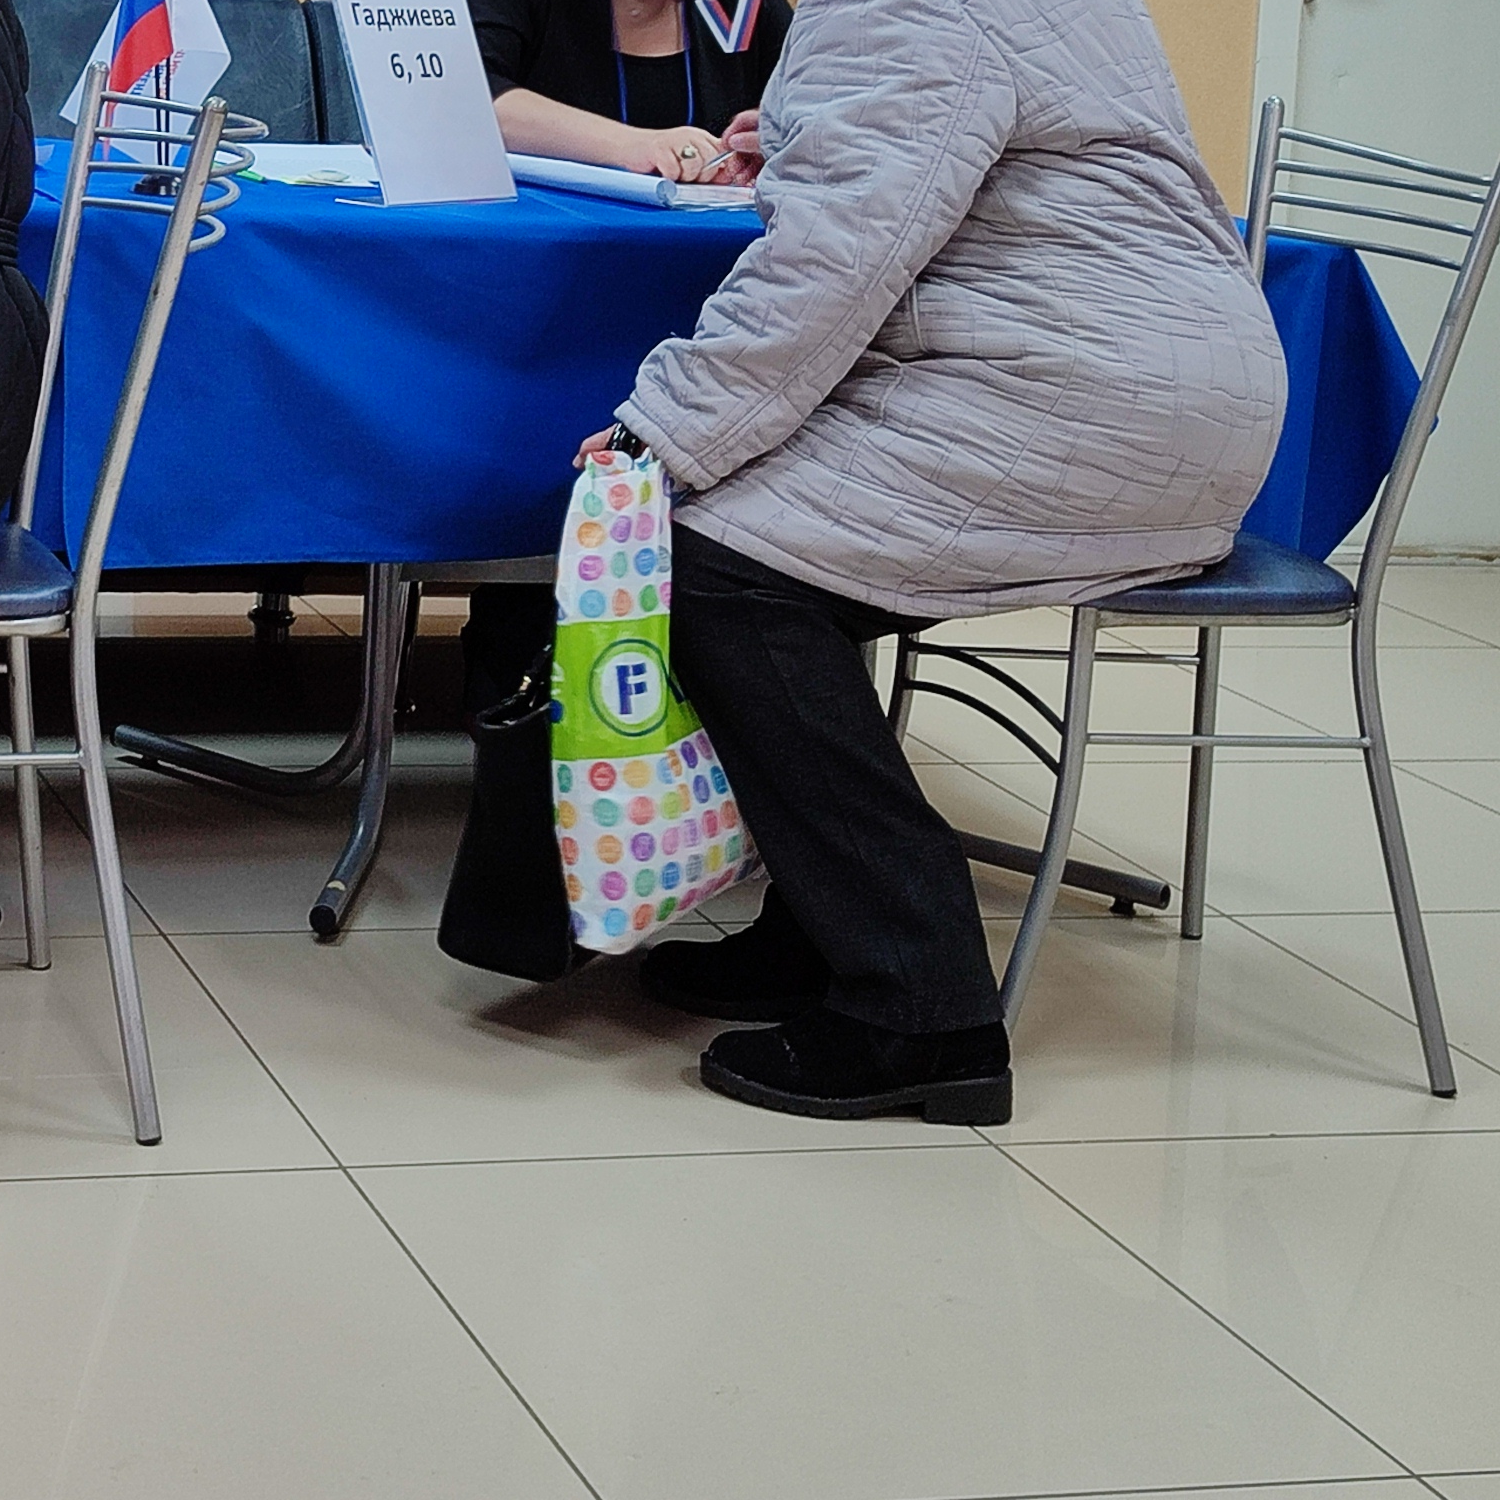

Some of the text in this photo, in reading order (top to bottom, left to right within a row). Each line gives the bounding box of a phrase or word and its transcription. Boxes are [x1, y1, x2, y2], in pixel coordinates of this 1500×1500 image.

[351, 2, 456, 31] Гаджиева
[390, 52, 443, 84] 6, 10
